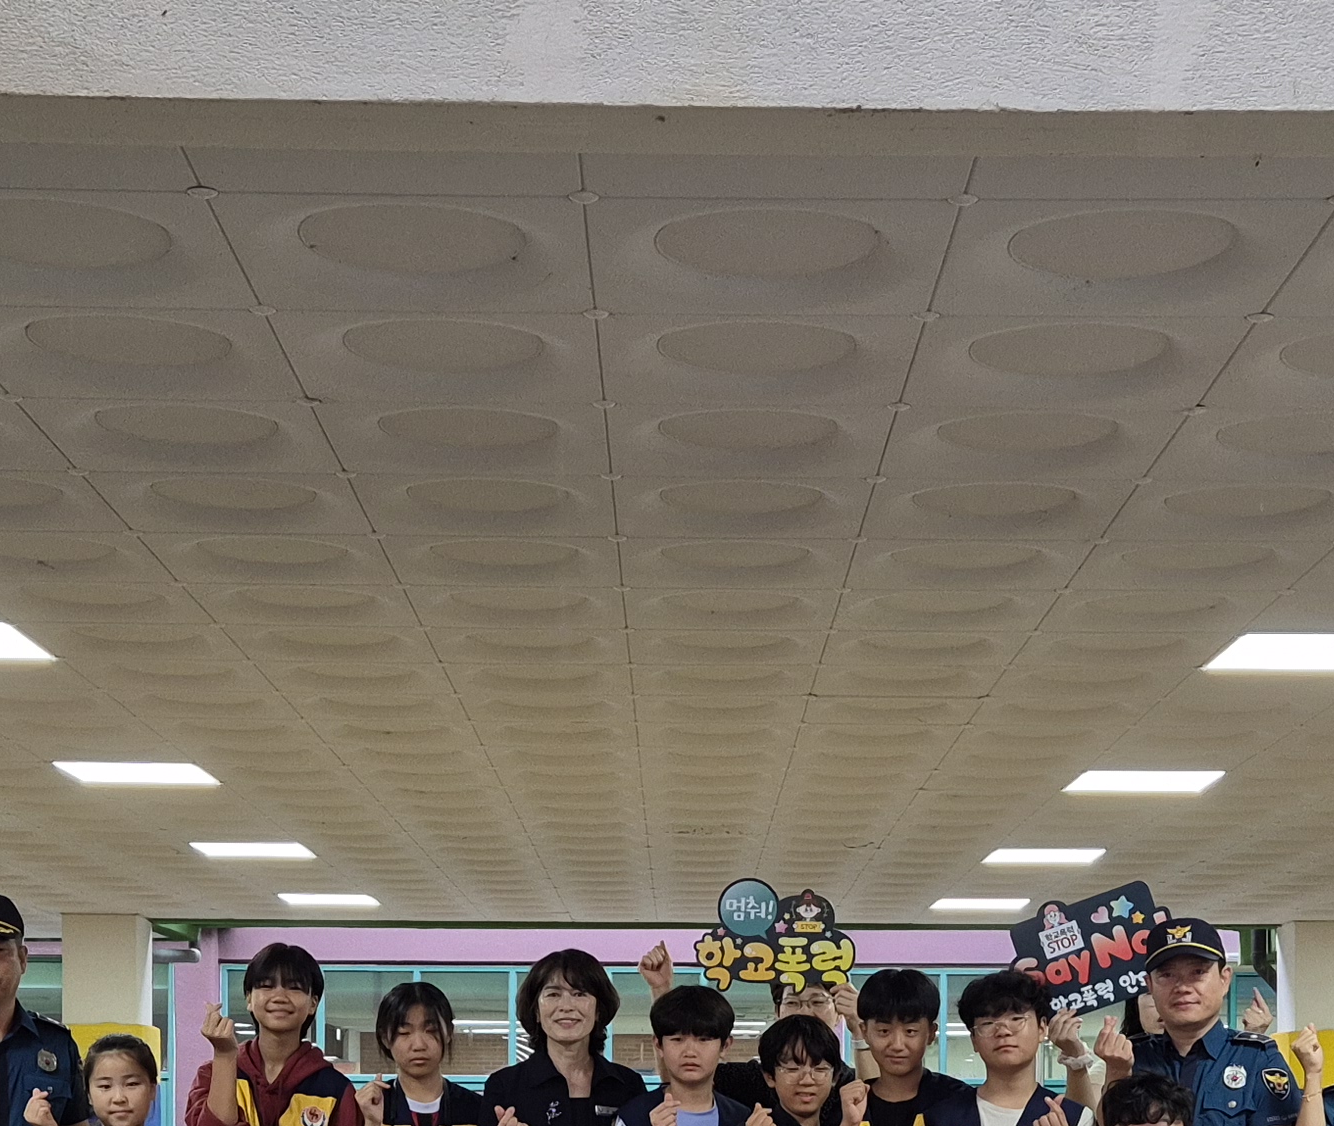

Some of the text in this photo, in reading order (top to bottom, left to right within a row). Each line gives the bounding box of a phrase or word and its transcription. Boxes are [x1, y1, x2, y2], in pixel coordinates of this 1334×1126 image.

[726, 896, 773, 920] 멈춰!
[1048, 934, 1077, 954] STOP
[696, 935, 853, 992] 학교폭력
